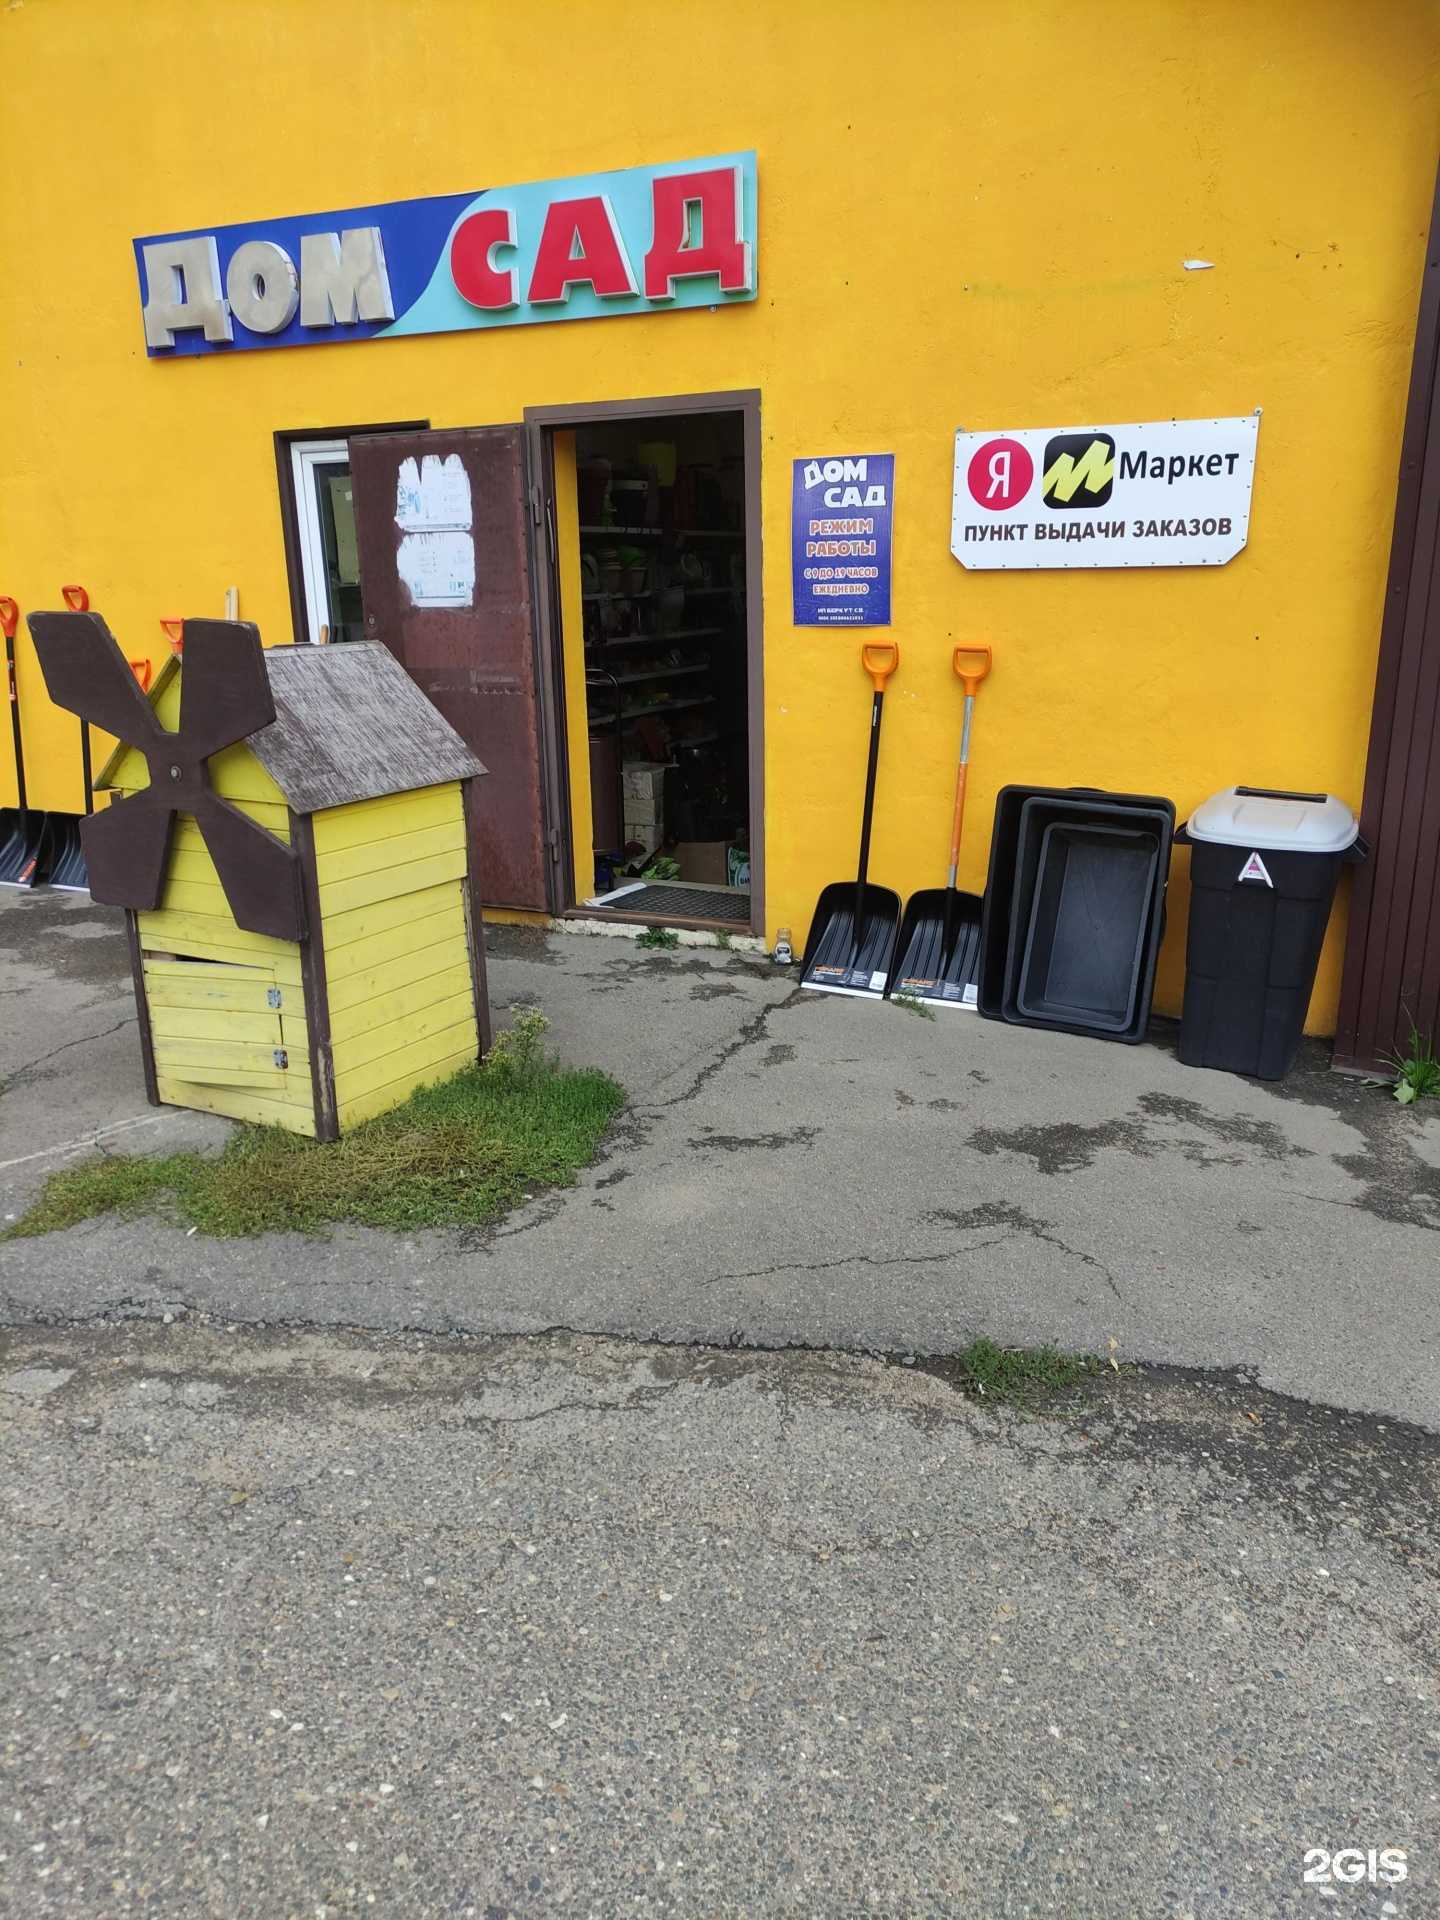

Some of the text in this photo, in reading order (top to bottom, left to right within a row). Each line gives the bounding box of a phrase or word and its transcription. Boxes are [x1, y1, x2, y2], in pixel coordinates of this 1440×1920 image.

[143, 166, 753, 349] ДОМ САД
[803, 458, 868, 490] ДОМ
[1119, 450, 1240, 485] Маркет
[823, 485, 887, 509] САД
[809, 518, 874, 536] РЕЖИМ
[963, 517, 1233, 543] ПУНКТ ВЫДАЧИ ЗАКАЗОВ
[806, 540, 876, 557] РАБОТЫ
[819, 567, 834, 580] ДО
[834, 567, 847, 579] 19
[847, 566, 879, 578] ЧАСОВ
[813, 583, 870, 596] ЕЖЕДНЕВНО
